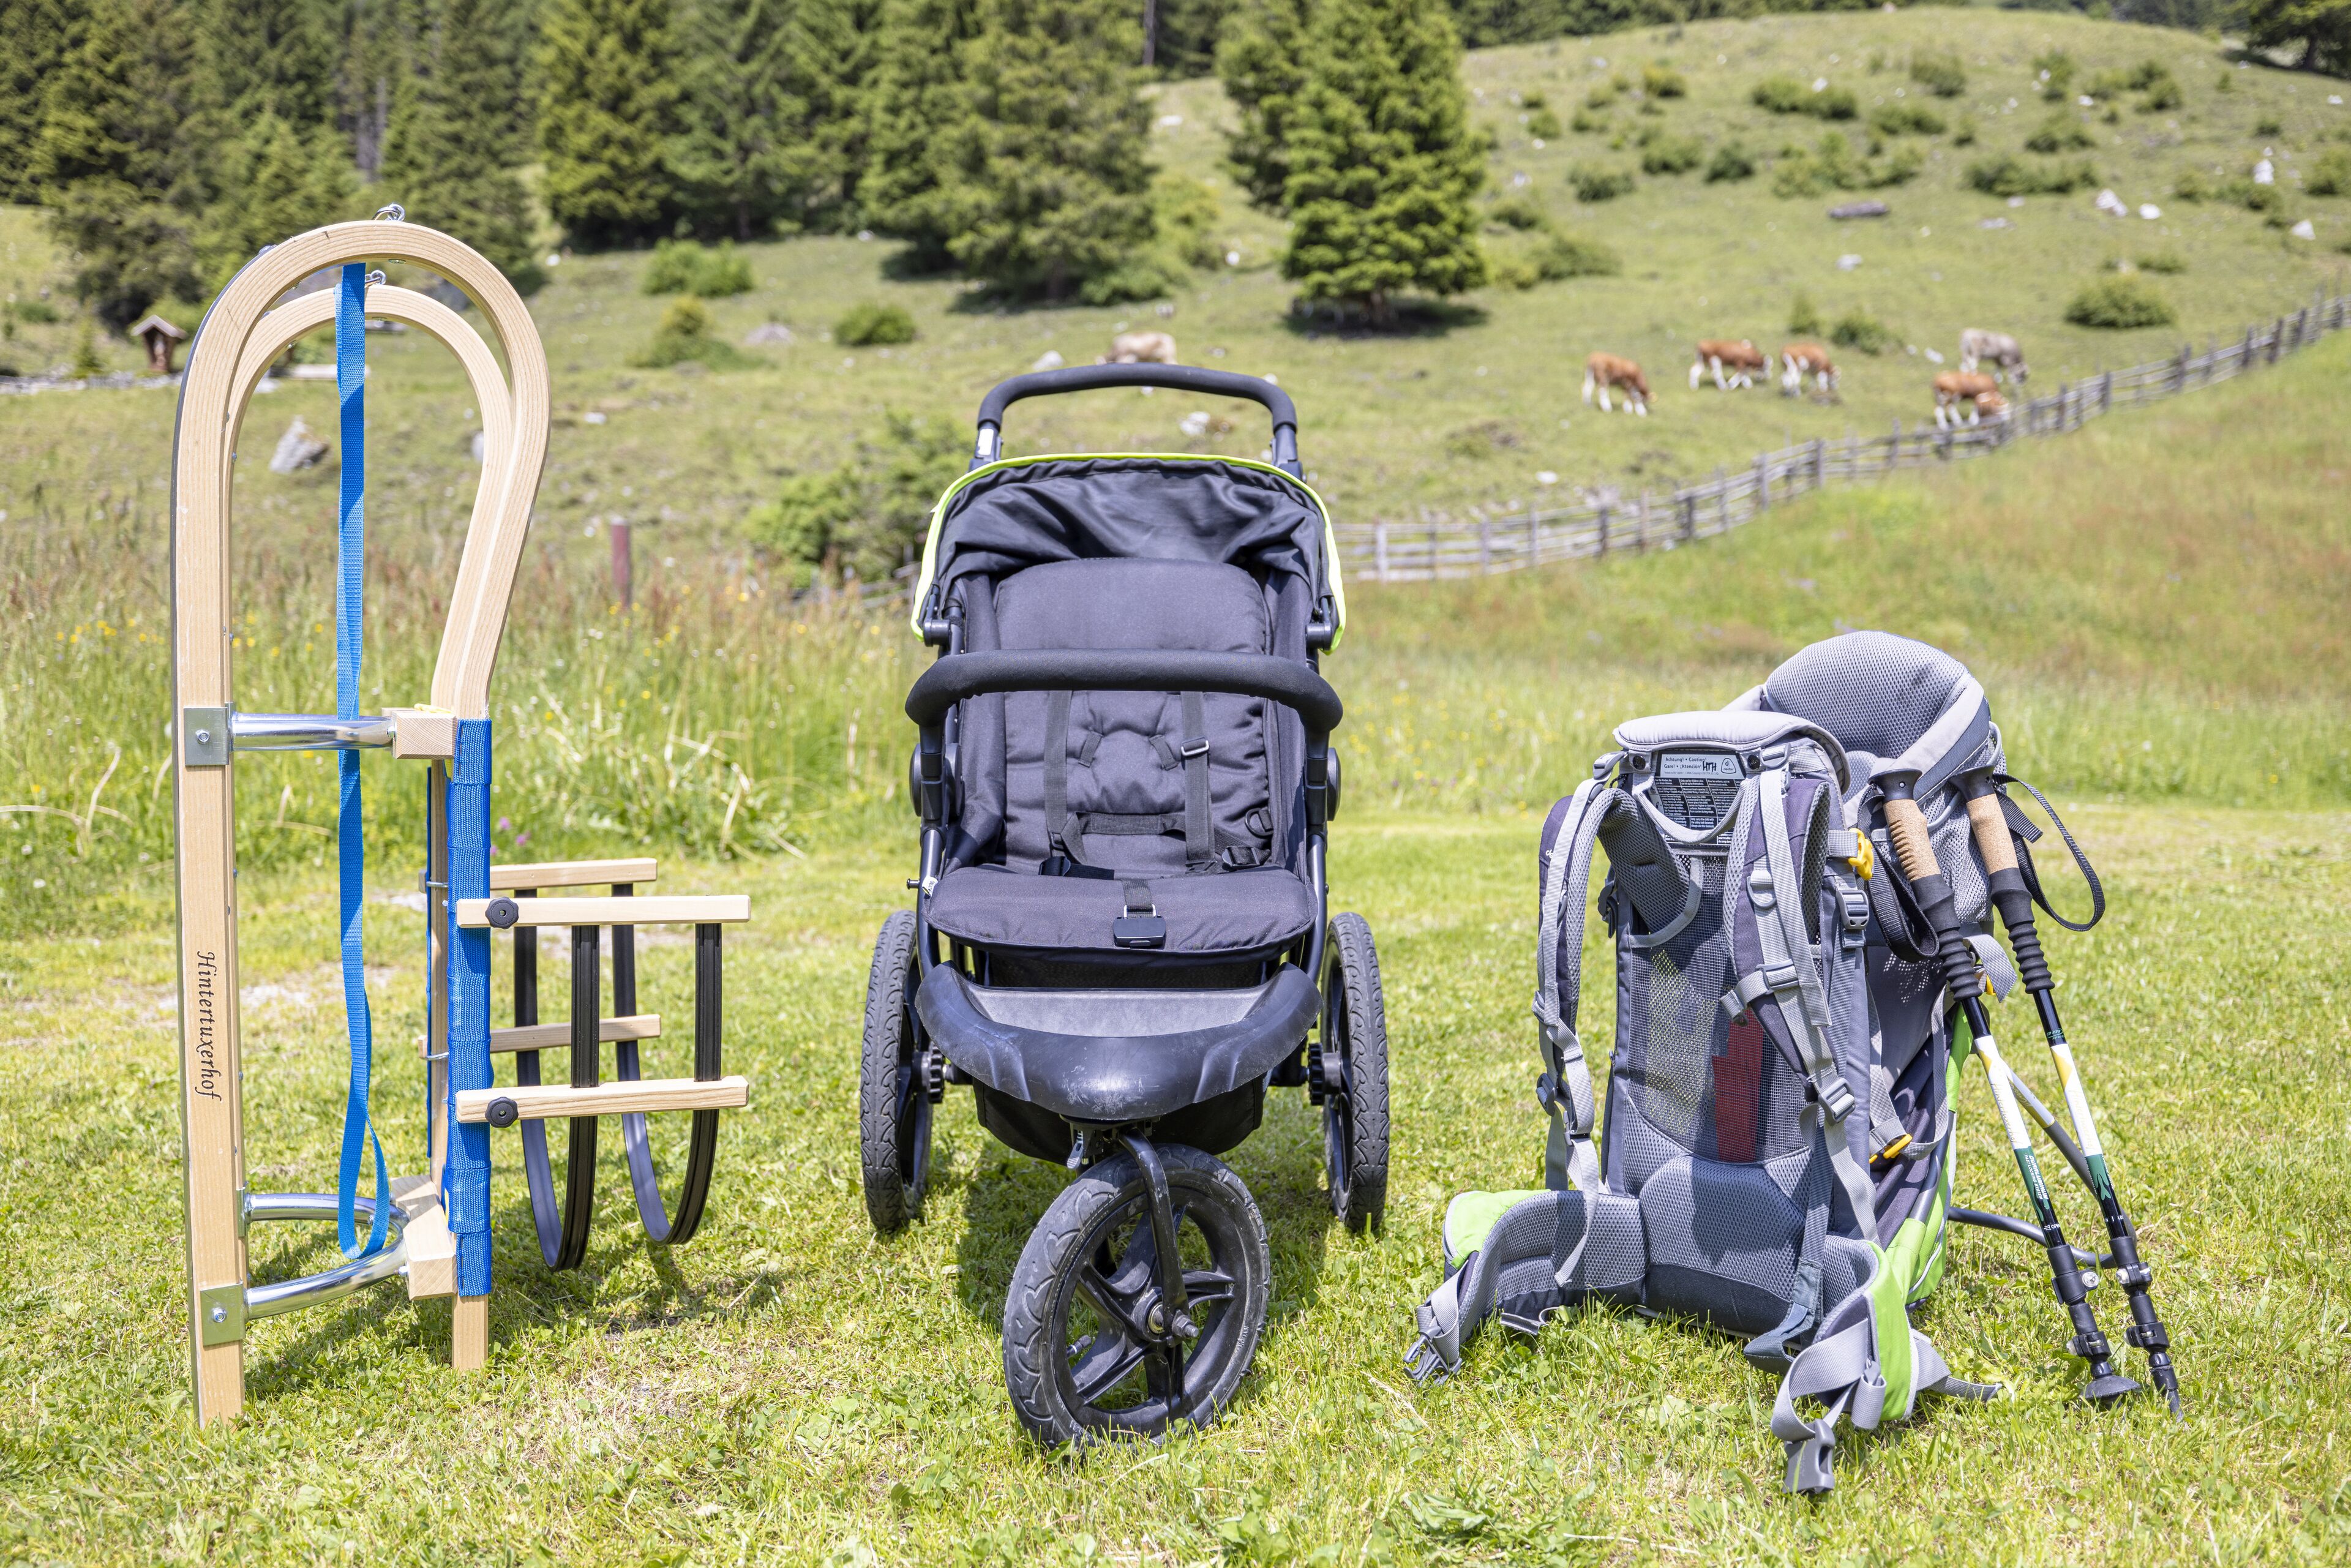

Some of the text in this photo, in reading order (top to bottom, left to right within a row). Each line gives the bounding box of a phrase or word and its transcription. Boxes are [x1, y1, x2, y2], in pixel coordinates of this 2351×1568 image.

[1703, 760, 1717, 772] HTH
[195, 951, 222, 1101] Hintertuxerhof
[2028, 1165, 2037, 1182] LOCKING
[2034, 1183, 2044, 1199] SYSTEM
